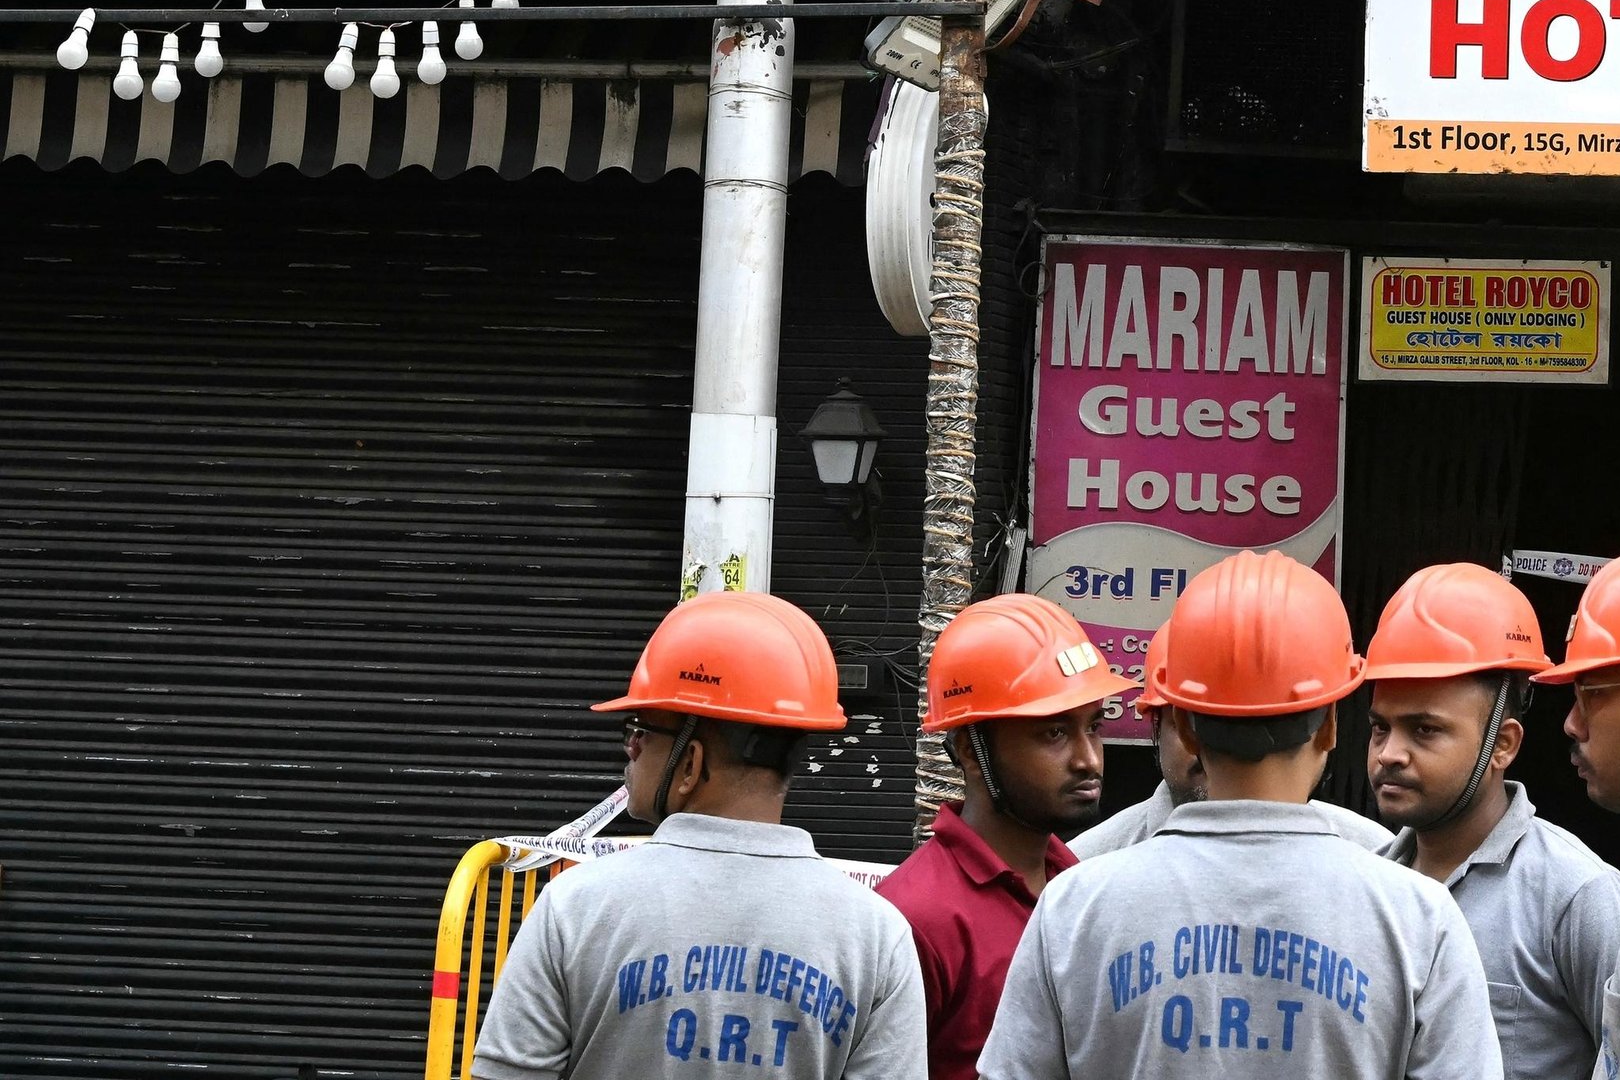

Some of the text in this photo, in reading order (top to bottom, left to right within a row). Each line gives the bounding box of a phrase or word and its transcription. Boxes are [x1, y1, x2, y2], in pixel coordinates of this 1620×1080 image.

[1393, 125, 1433, 152] 1st
[1441, 126, 1517, 155] Floor,
[1524, 132, 1571, 156] 15G,
[1382, 274, 1592, 310] HOTEL ROYCO
[1050, 262, 1330, 375] MARIAM
[1386, 310, 1577, 328] GUEST HOUSE ONLY LODGING
[1406, 327, 1483, 348] হোটেল
[1398, 355, 1520, 367] MIRZA GALIB STREET, 3rd FLOOR, KOL
[1078, 384, 1297, 441] Guest
[1066, 457, 1302, 515] House
[1516, 557, 1547, 572] POLICE
[1065, 565, 1135, 600] 3rd
[1506, 632, 1532, 643] KARAM
[679, 671, 721, 686] KARAM
[1109, 924, 1370, 1023] W.B. CIVIL DEFENCE
[618, 945, 857, 1048] W.B. CIVIL DEFENCE
[666, 1008, 799, 1067] Q.R.T
[1161, 995, 1303, 1053] Q.R.T
